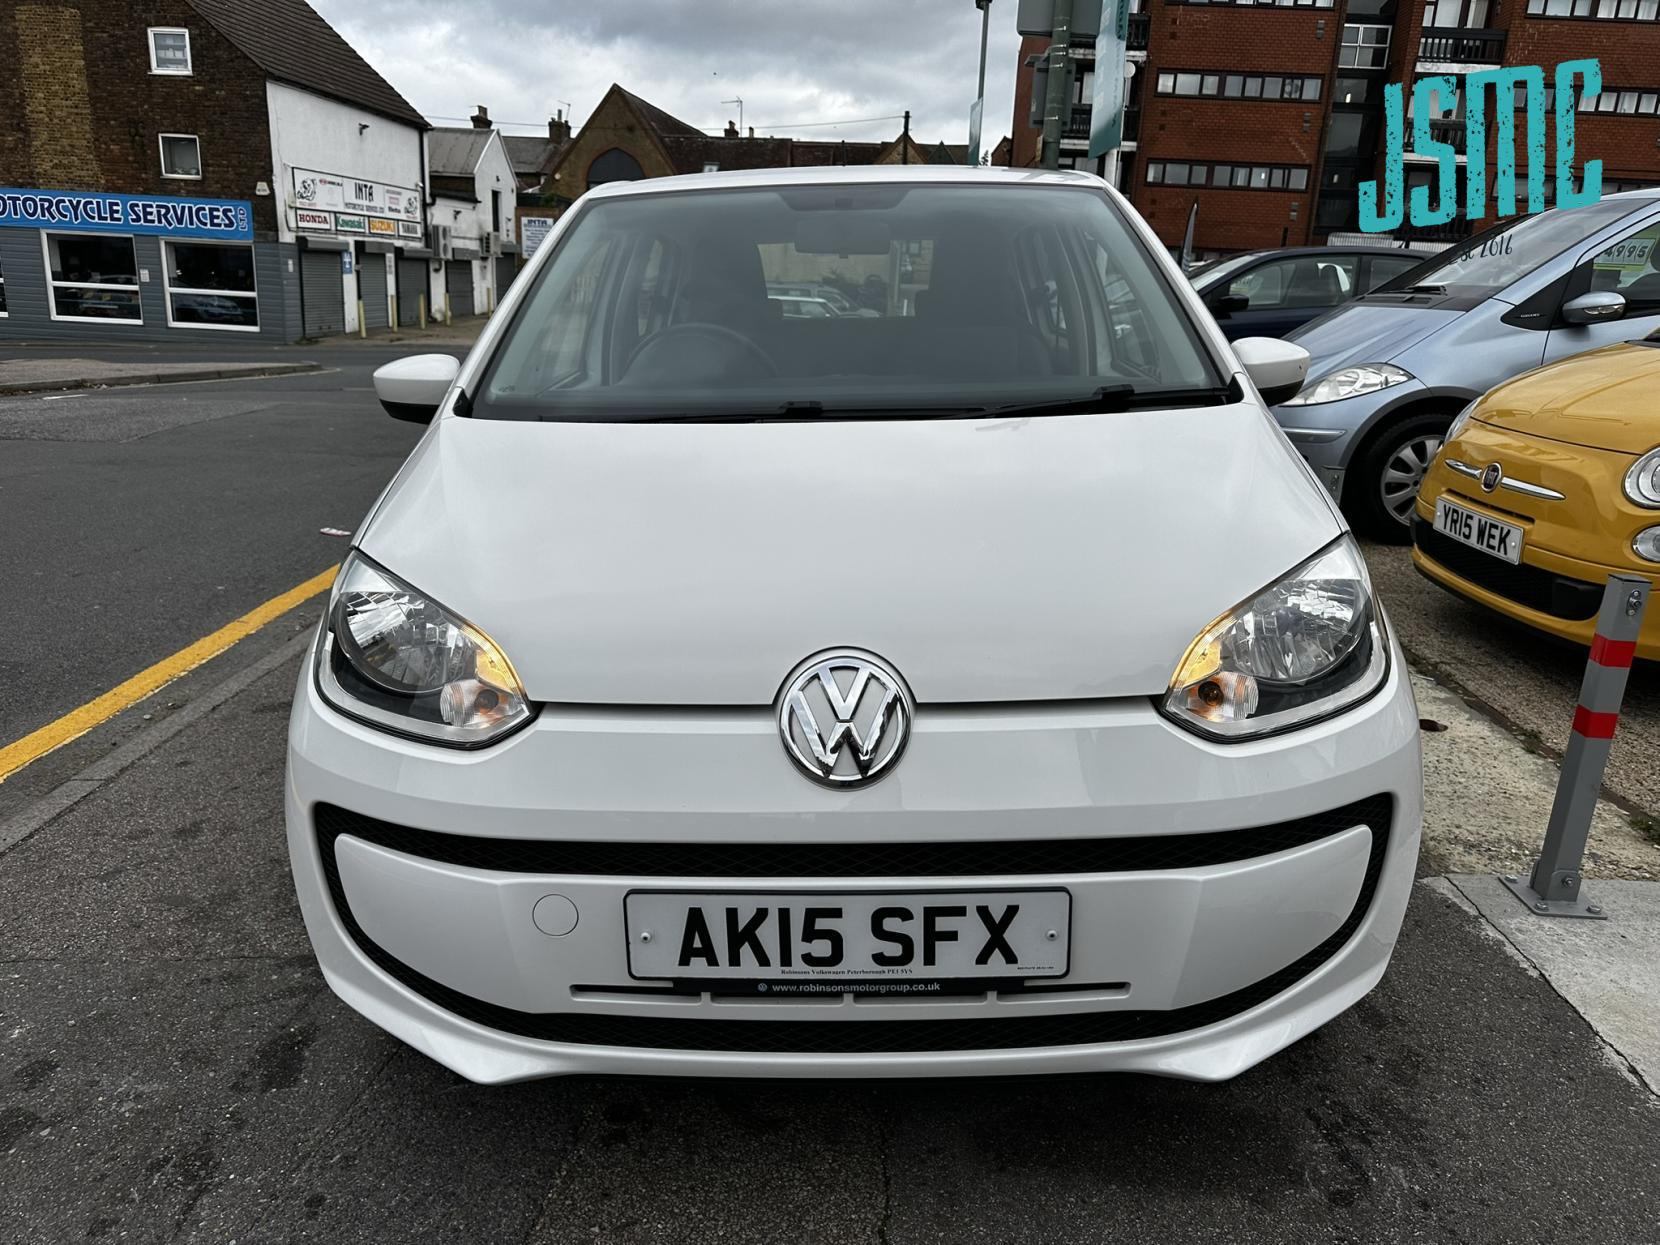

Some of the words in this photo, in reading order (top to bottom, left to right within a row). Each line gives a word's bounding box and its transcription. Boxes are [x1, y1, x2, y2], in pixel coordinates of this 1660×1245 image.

[354, 182, 374, 202] INTA
[127, 200, 237, 231] SERVICES
[238, 207, 248, 232] LTD
[298, 213, 329, 225] HONDA
[1603, 245, 1649, 258] 4995
[1443, 504, 1474, 541] YR15
[1476, 517, 1511, 556] WEK
[678, 906, 844, 968] AK15
[870, 904, 1020, 968] SFX
[772, 982, 941, 994] www.robinsonsmotorgroup.co.uk
